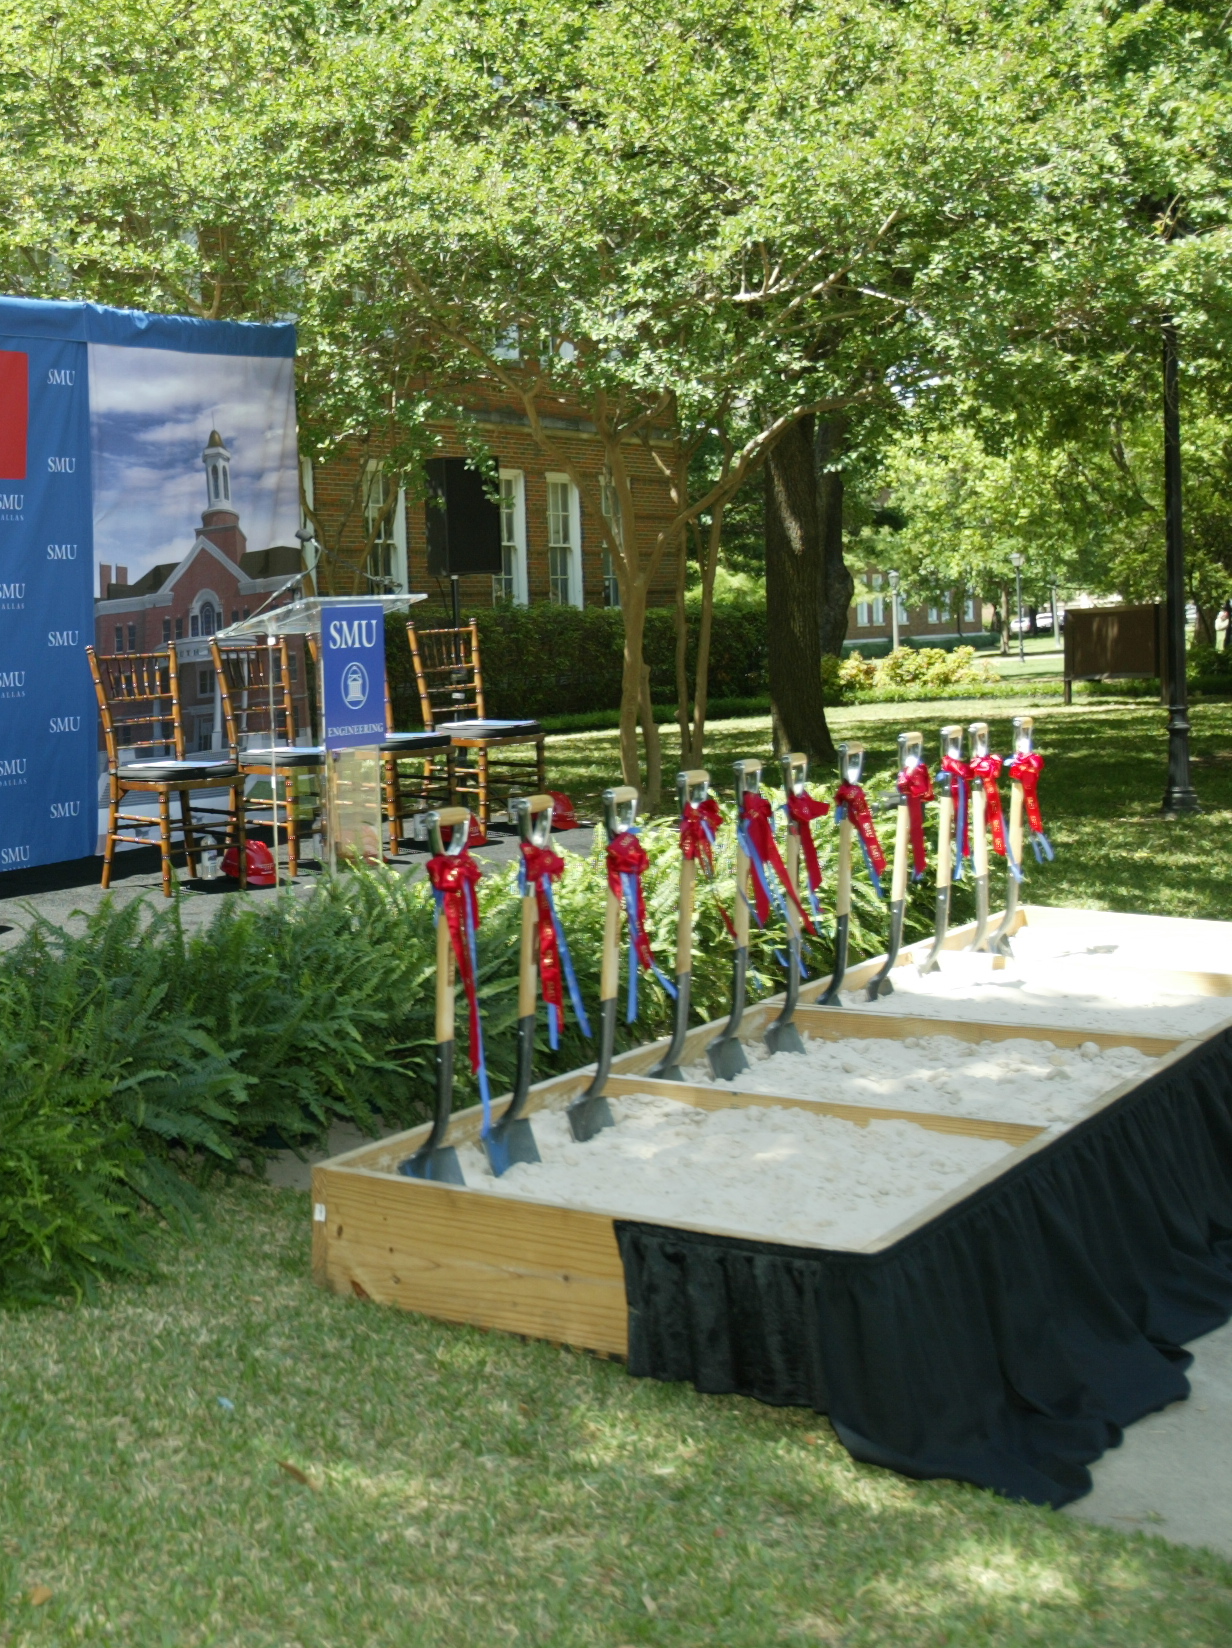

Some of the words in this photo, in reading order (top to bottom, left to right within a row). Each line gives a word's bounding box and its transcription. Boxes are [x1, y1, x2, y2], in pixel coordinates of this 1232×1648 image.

[47, 369, 75, 385] SMU
[47, 457, 76, 473] SMU
[46, 545, 78, 559] SMU
[48, 631, 79, 646] SMU
[329, 620, 377, 649] SMU
[49, 717, 81, 732] SMU
[328, 723, 384, 737] ENGINEERING
[49, 801, 81, 818] SMU
[1, 846, 30, 864] SMU
